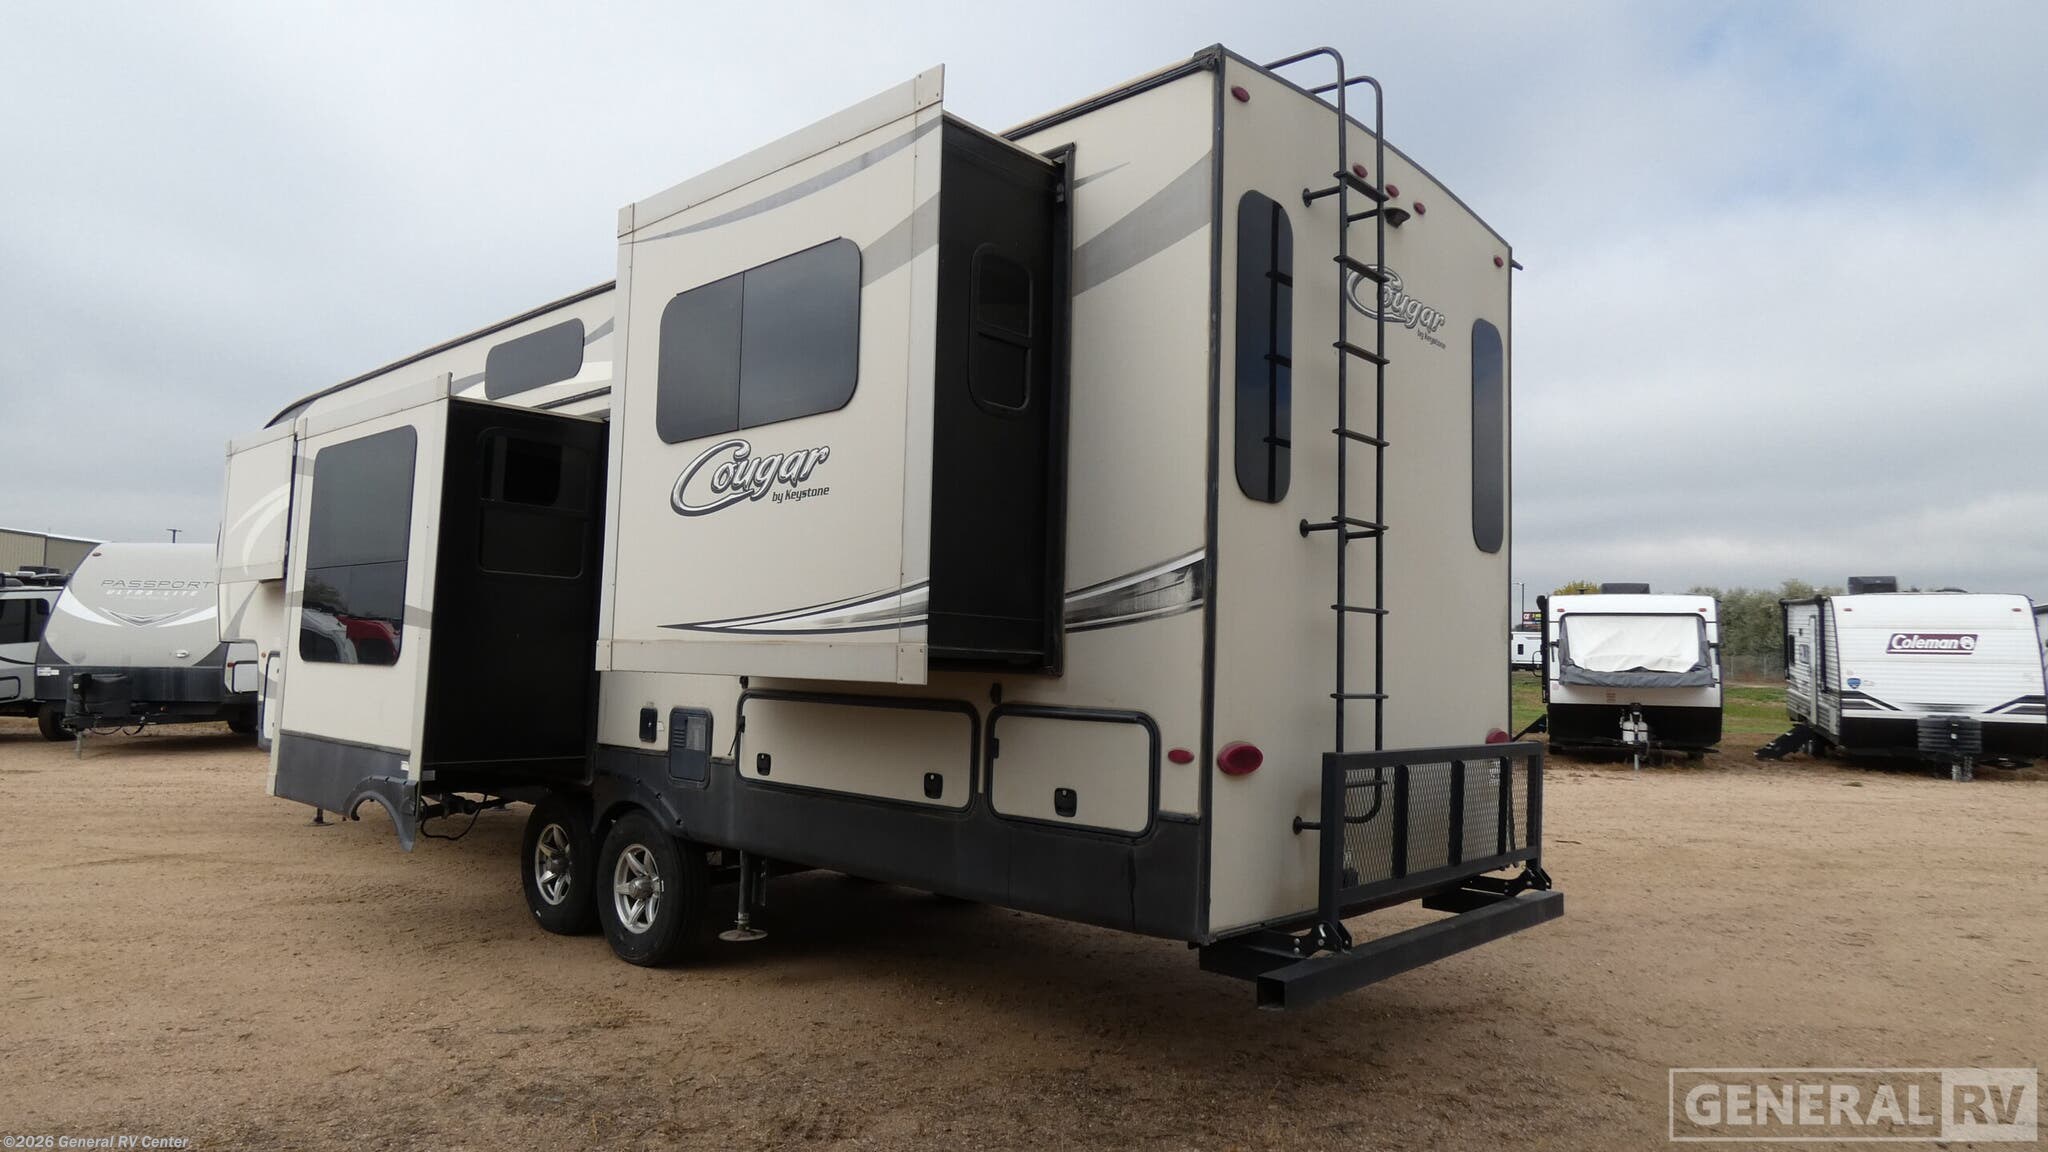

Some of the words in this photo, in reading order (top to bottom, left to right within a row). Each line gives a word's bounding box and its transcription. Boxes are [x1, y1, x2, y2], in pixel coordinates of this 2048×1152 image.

[1346, 264, 1446, 333] Cougar
[670, 439, 830, 517] Cougar
[772, 490, 784, 503] by
[785, 486, 830, 502] Keystone
[101, 579, 214, 589] PASSPORT
[1892, 635, 1959, 649] Coleman
